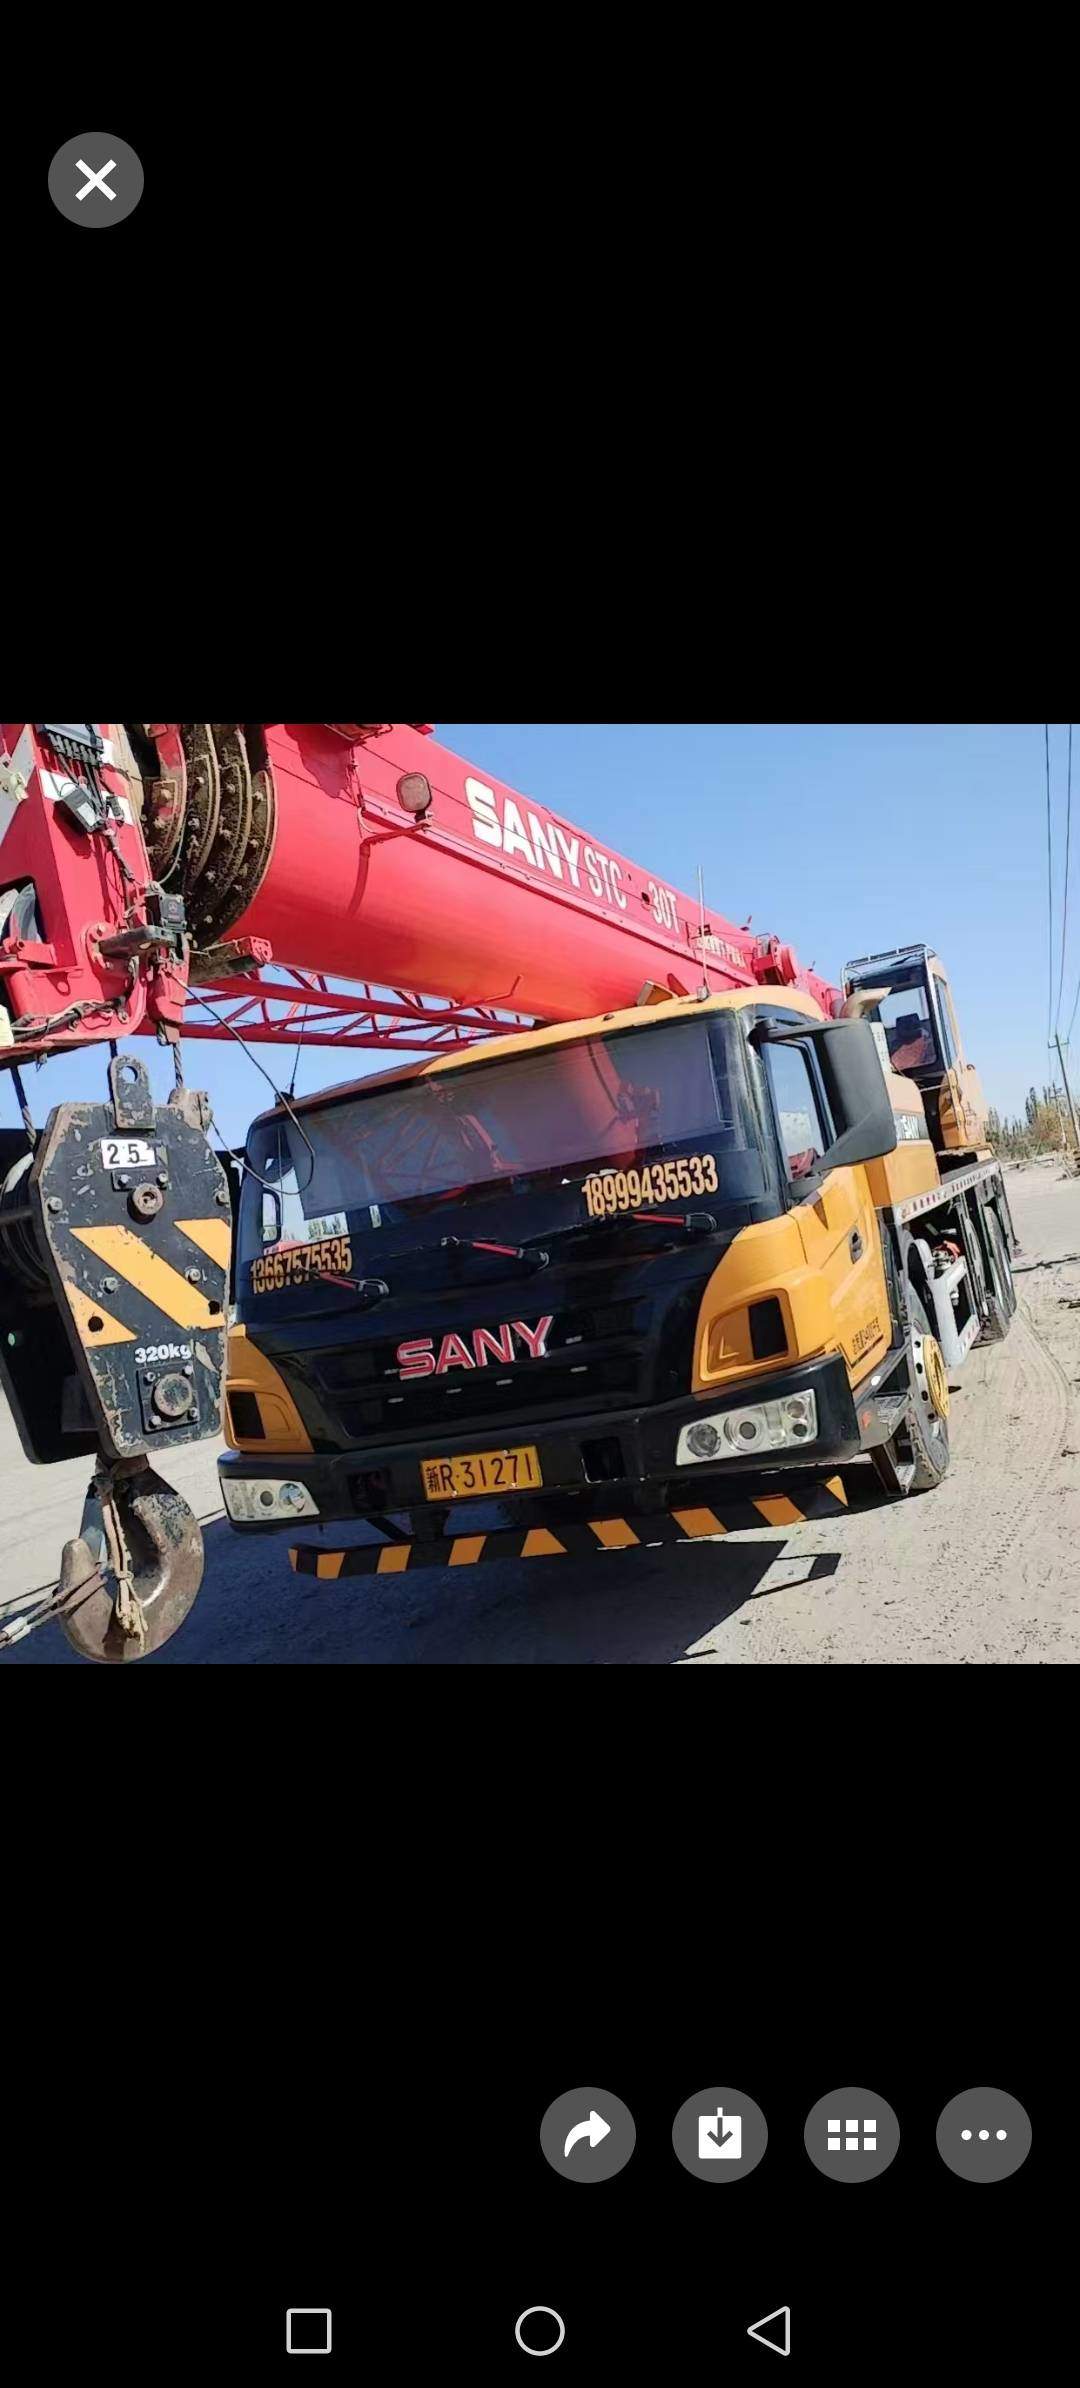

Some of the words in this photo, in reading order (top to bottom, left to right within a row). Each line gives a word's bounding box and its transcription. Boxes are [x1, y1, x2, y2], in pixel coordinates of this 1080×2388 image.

[464, 776, 581, 888] SANY
[584, 845, 627, 909] STC
[648, 880, 681, 934] 30T
[581, 1153, 719, 1217] 18999435533
[250, 1236, 353, 1295] 13667575535
[134, 1342, 192, 1364] 320kg
[396, 1315, 553, 1381] SANY
